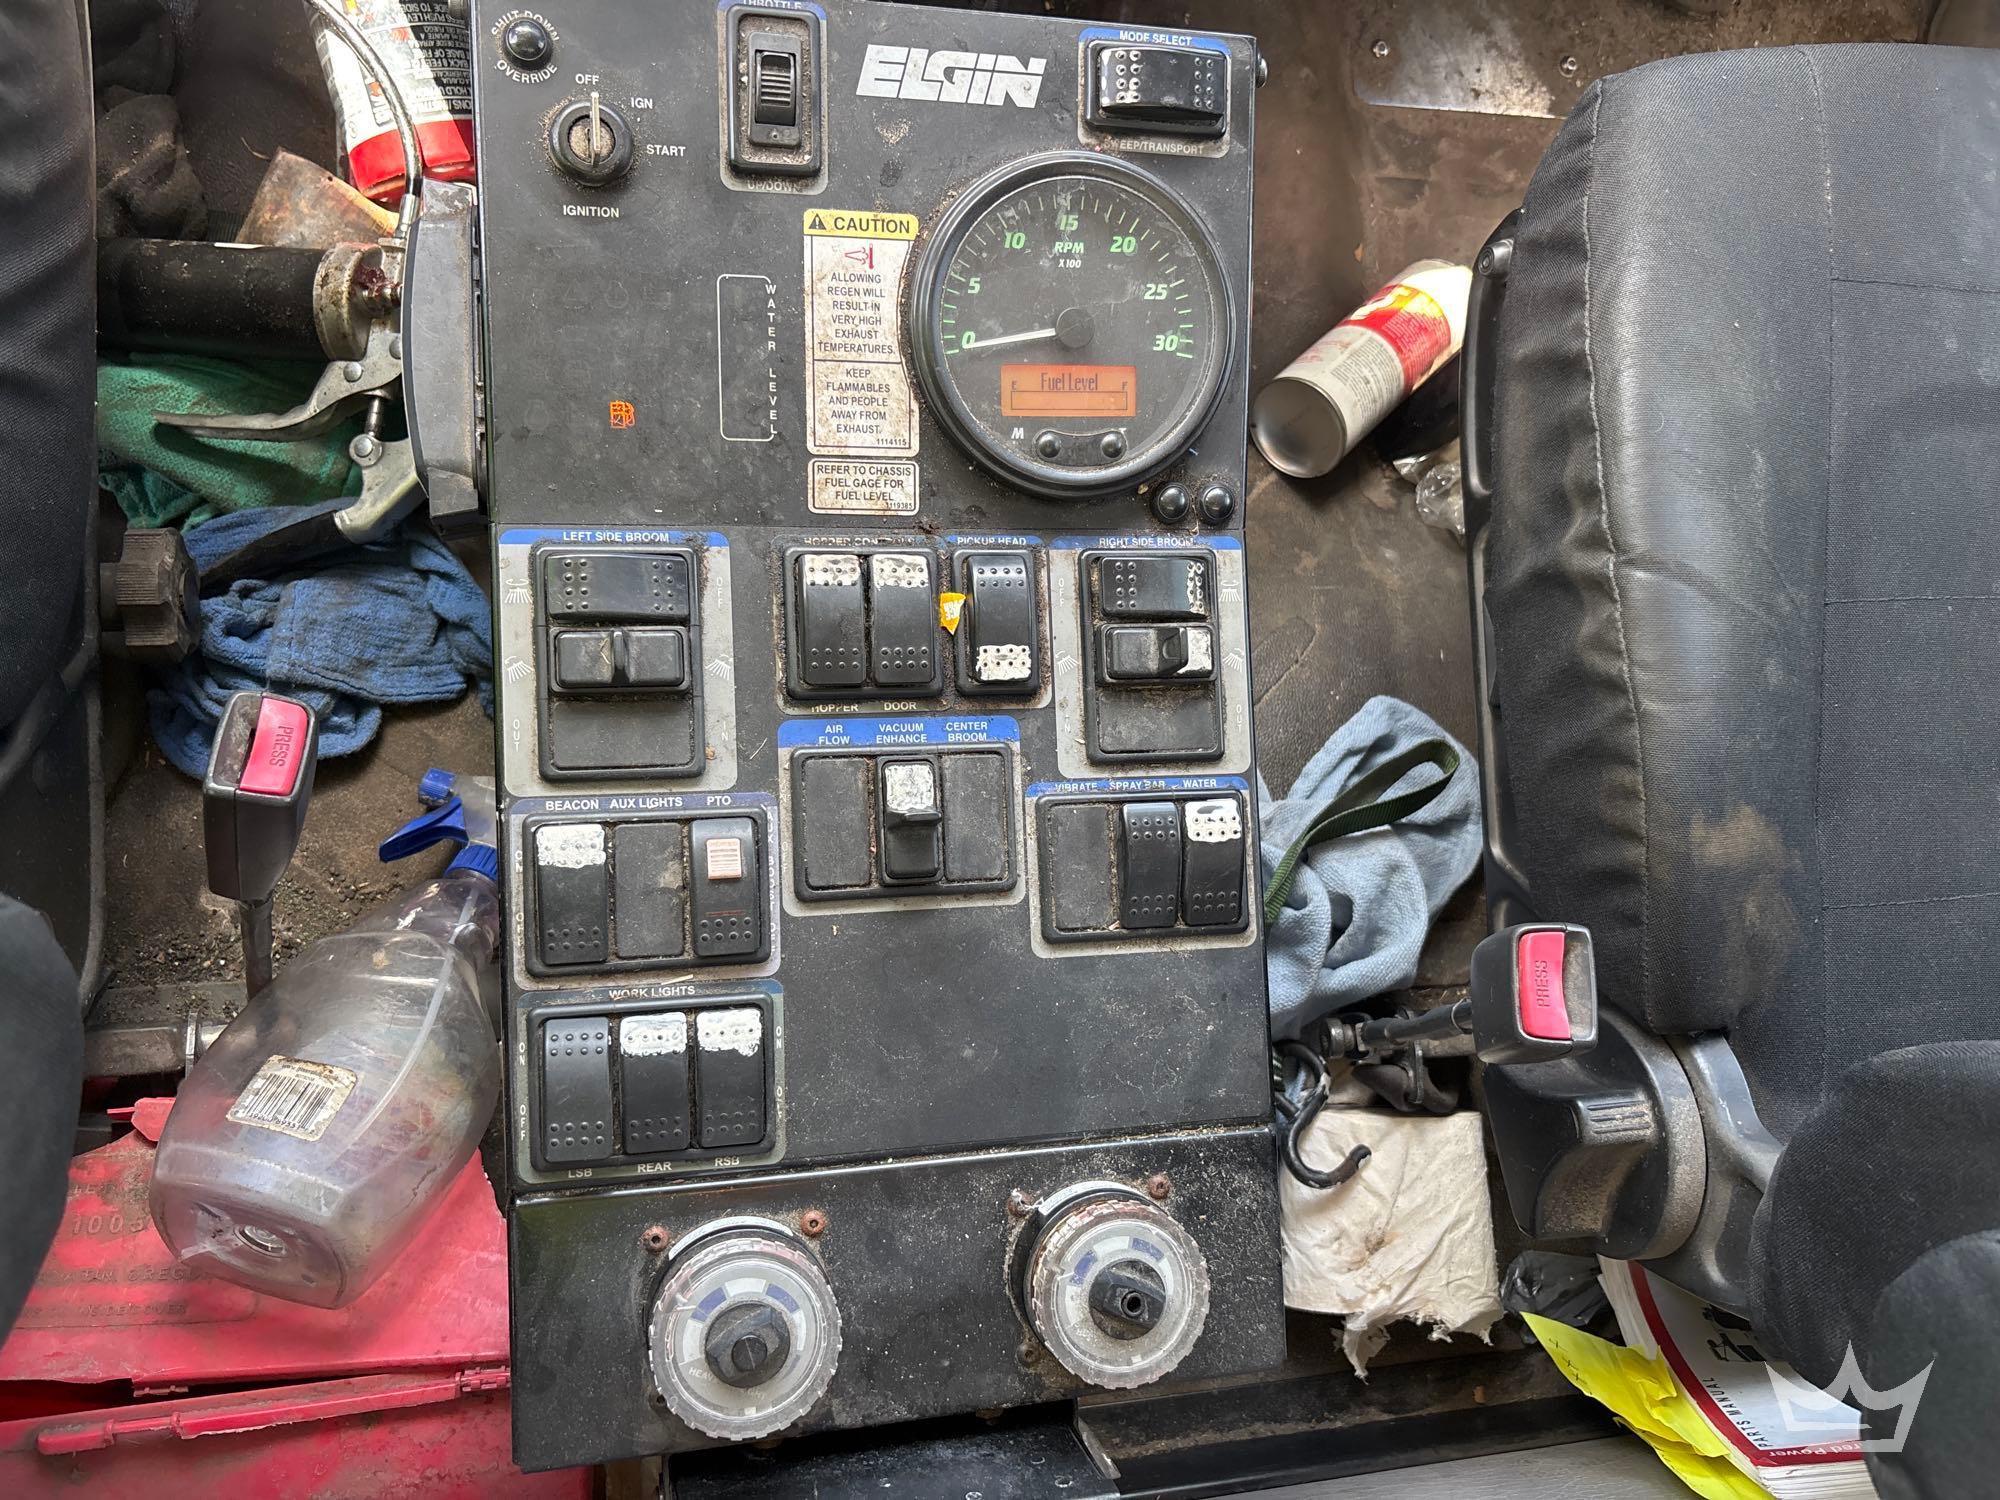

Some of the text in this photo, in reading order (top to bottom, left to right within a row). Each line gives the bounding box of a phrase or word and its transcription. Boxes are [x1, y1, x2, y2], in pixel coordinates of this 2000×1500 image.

[1119, 30, 1192, 46] MODE SELECT
[496, 60, 558, 84] OVERRIDE
[856, 44, 1047, 109] ELGIN
[575, 73, 599, 85] OFF
[631, 97, 653, 109] IGN
[646, 144, 686, 157] START
[1103, 138, 1204, 155] SWEEP/TRANSPORT
[562, 205, 620, 218] IGNITION
[834, 216, 910, 234] CAUTION
[1060, 215, 1079, 231] 15
[1004, 232, 1025, 249] 10
[1110, 236, 1136, 253] 20
[1054, 242, 1084, 254] RPM
[1058, 259, 1082, 269] X100
[830, 272, 882, 284] ALLOWING
[968, 278, 981, 294] 5
[1143, 284, 1167, 300] 25
[827, 287, 886, 298] REGEN WILL
[832, 301, 881, 311] RESULT IN
[765, 284, 777, 351] WATER
[832, 315, 882, 326] VERY HIGH
[835, 329, 879, 339] EXHAUST
[961, 331, 975, 348] 0
[818, 341, 896, 354] TEMPERATURES.
[1153, 335, 1178, 351] 30
[845, 369, 871, 378] KEEP
[826, 382, 891, 393] FLAMMABLES
[1041, 373, 1098, 391] Fuel Level
[769, 368, 777, 434] LEVEL
[829, 396, 888, 407] AND PEOPLE
[831, 410, 886, 421] AWAY FROM
[836, 425, 882, 434] EXHAUST.
[817, 465, 911, 476] REFER TO CHASSIS
[825, 478, 904, 489] FUEL GAGE FOR
[835, 491, 893, 501] FUEL LEVEL
[563, 531, 669, 543] LEFT SIDE BROOM
[957, 536, 1027, 546] PICKUP HEAD
[1099, 537, 1193, 547] RIGHT SIDE BROOM
[811, 701, 917, 713] HOPPER DOOR
[825, 724, 843, 734] AIR
[879, 723, 924, 733] VACUUM
[946, 722, 988, 732] CENTER
[819, 735, 850, 745] FLOW
[876, 734, 927, 744] ENHANCE
[948, 733, 987, 743] BROOM
[269, 725, 294, 767] PRESS
[1055, 782, 1097, 792] VIBRATE
[1109, 781, 1141, 790] SPRAY
[1183, 779, 1217, 788] WATER
[545, 795, 732, 811] BEACON AUX LIGHTS PTO
[515, 850, 523, 873] ON
[1535, 960, 1550, 1008] PRESS
[609, 985, 695, 999] WORK LIGHTS
[776, 1026, 782, 1048] ON
[518, 1042, 525, 1066] ON
[637, 1161, 672, 1173] REAR
[715, 1157, 740, 1167] RSB
[568, 1168, 593, 1178] LSB
[688, 1367, 717, 1382] HEAV
[1702, 1377, 1774, 1447] PARTS MANUAL
